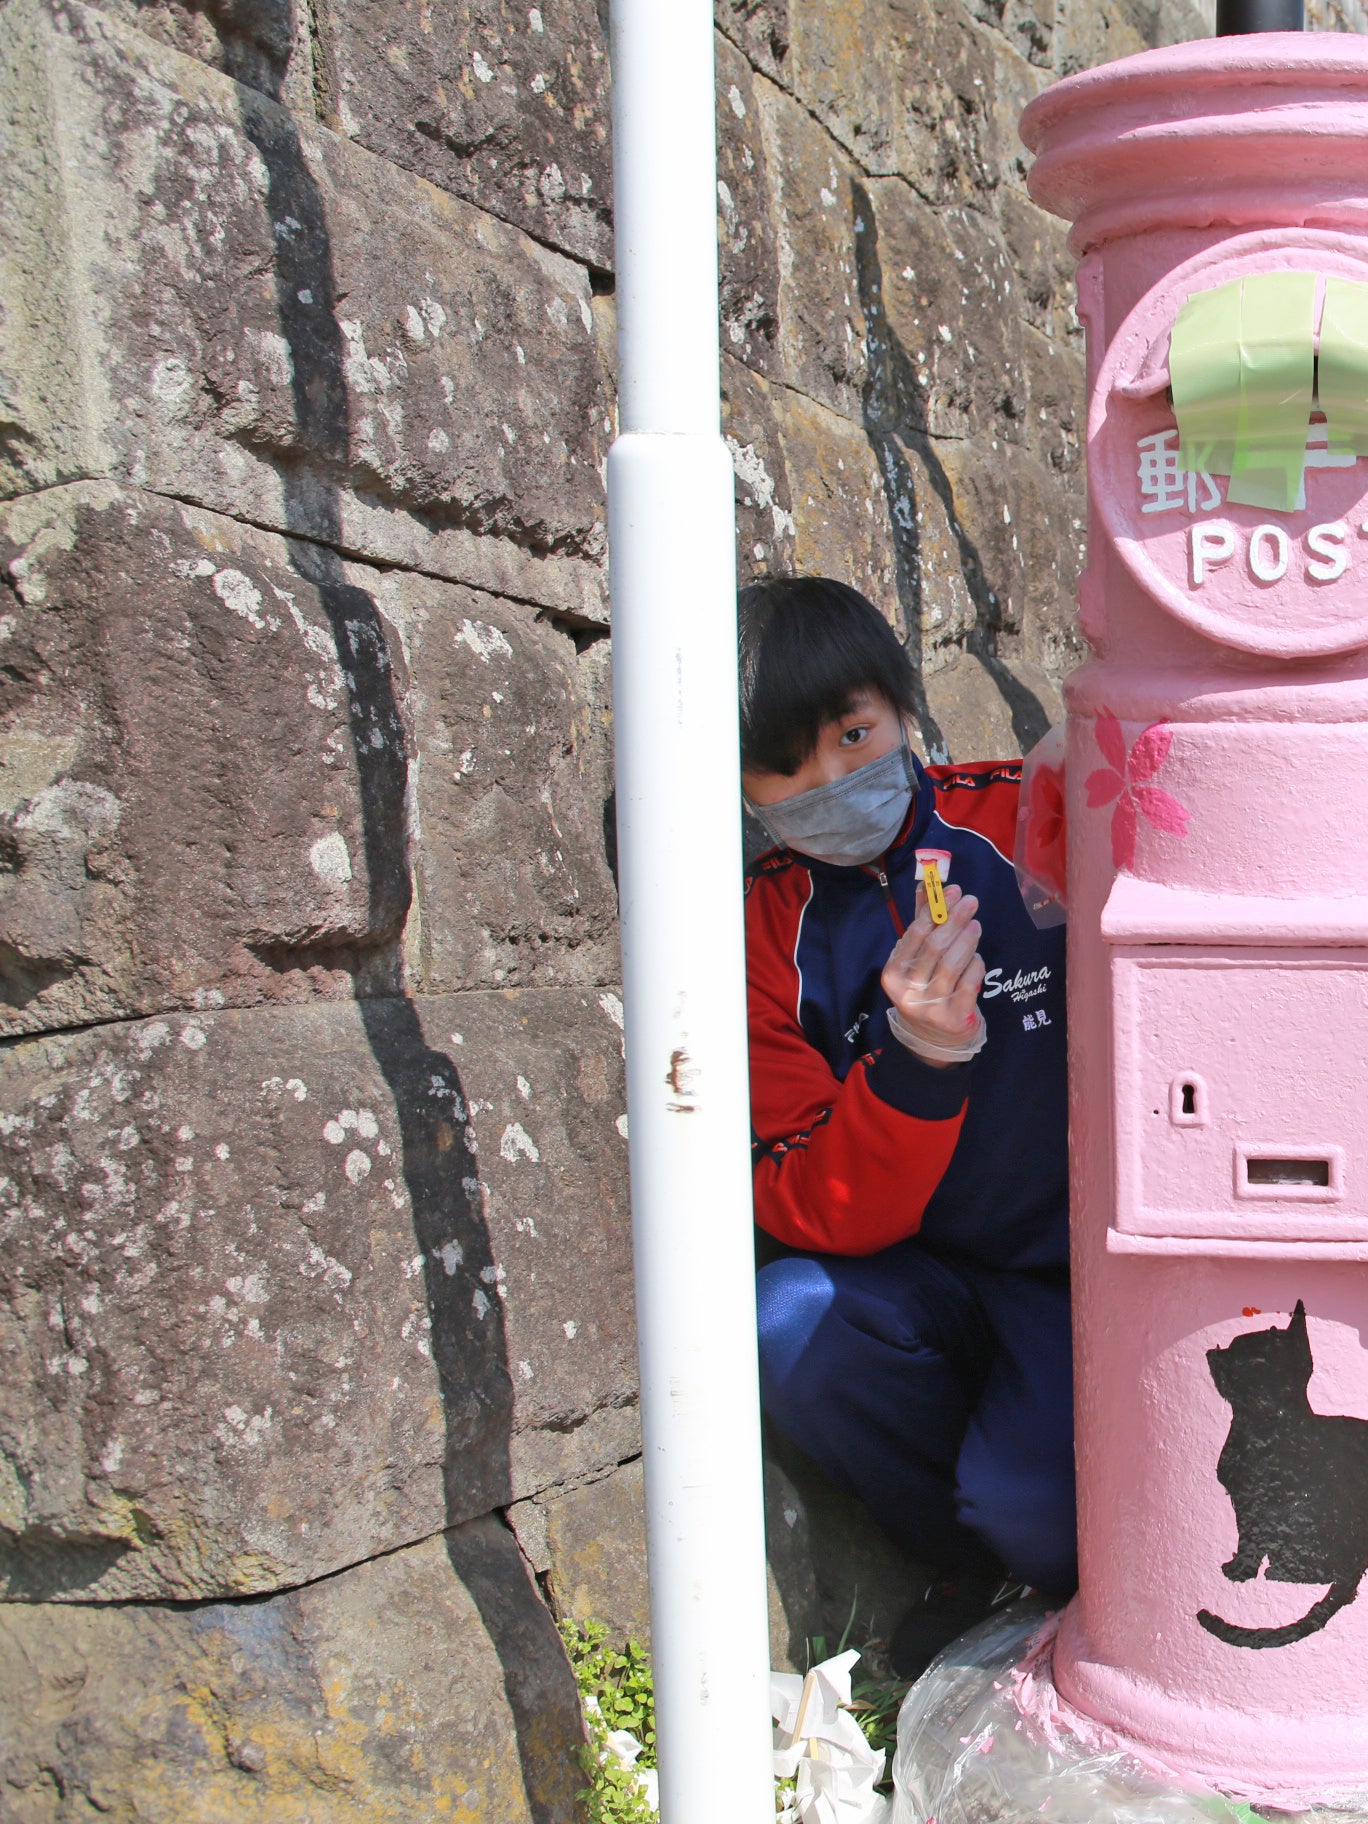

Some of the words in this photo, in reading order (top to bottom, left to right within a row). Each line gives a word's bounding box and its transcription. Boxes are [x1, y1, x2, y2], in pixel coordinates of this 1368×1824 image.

[983, 966, 1052, 998] Sakura
[1011, 984, 1047, 1003] Higashi
[1022, 1009, 1052, 1032] 能見
